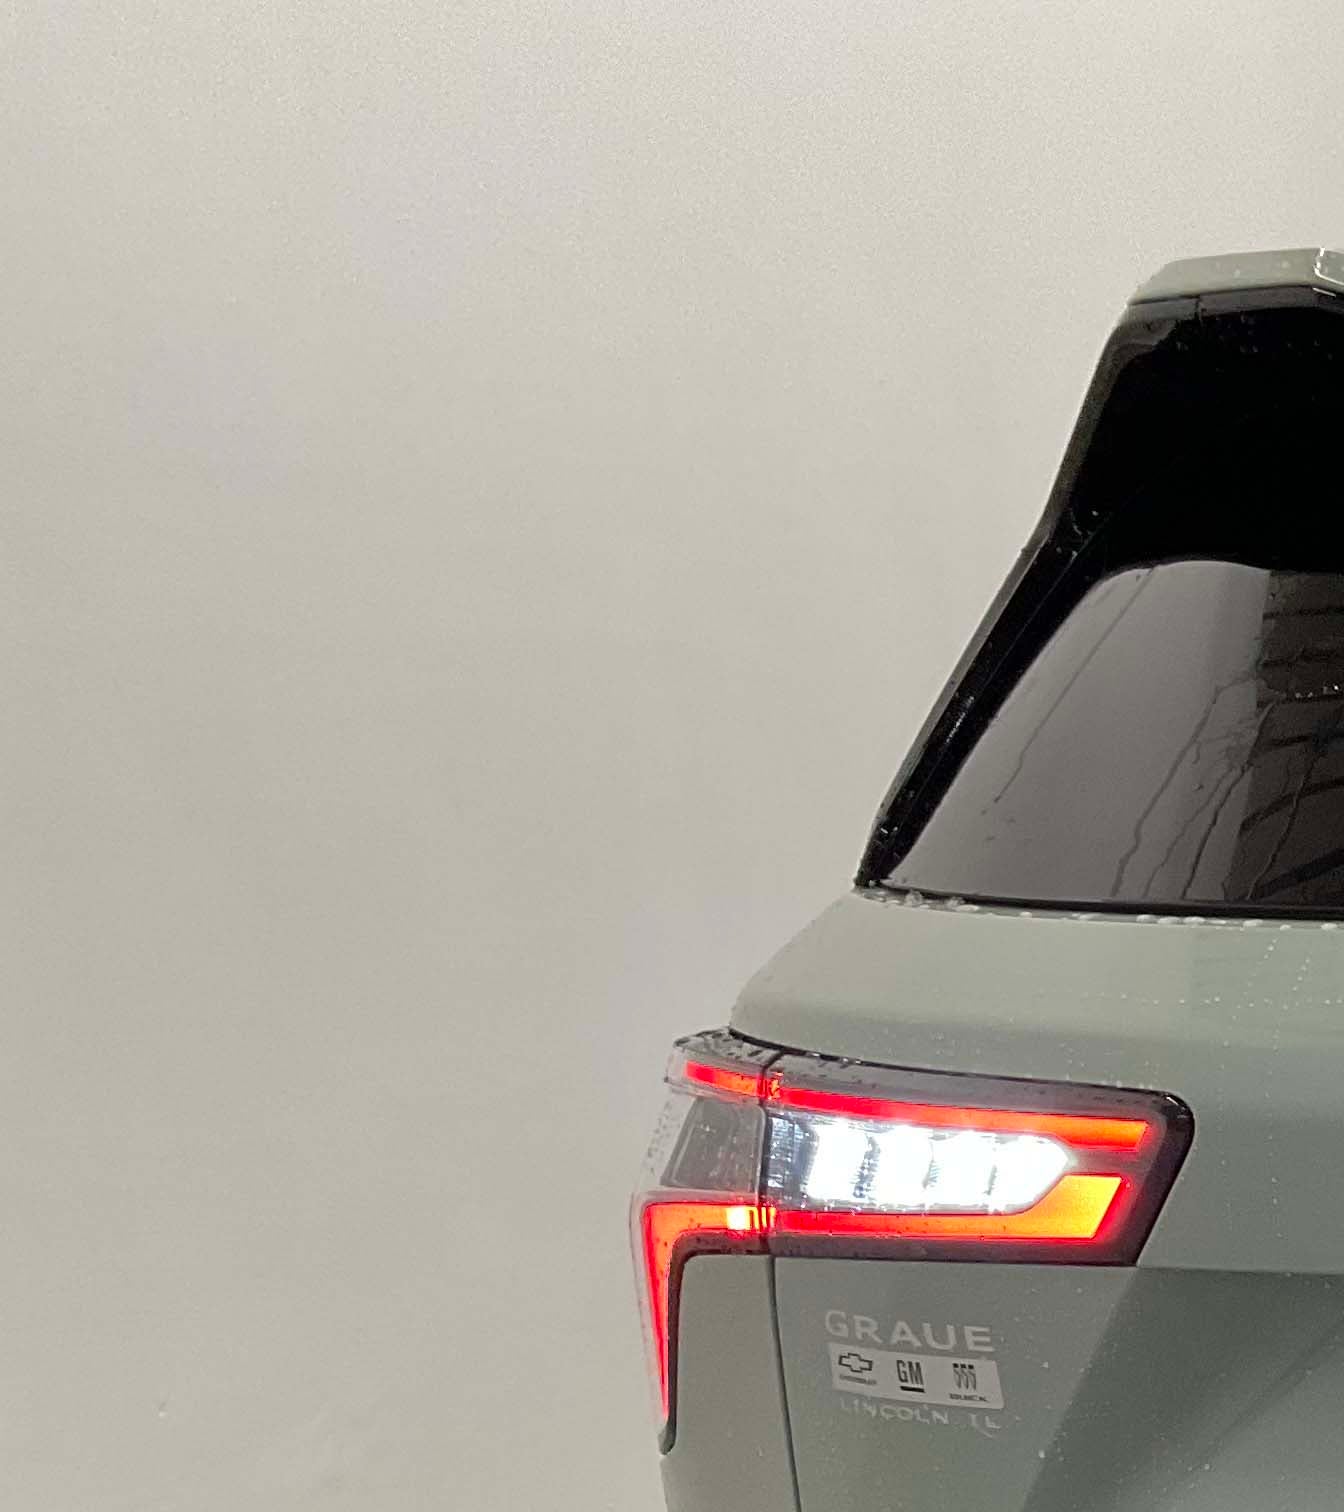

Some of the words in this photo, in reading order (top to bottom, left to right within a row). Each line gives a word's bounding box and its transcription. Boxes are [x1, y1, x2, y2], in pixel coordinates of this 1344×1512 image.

[825, 1309, 995, 1353] GRAUE
[896, 1359, 925, 1386] GM
[840, 1398, 949, 1425] LINCOLN
